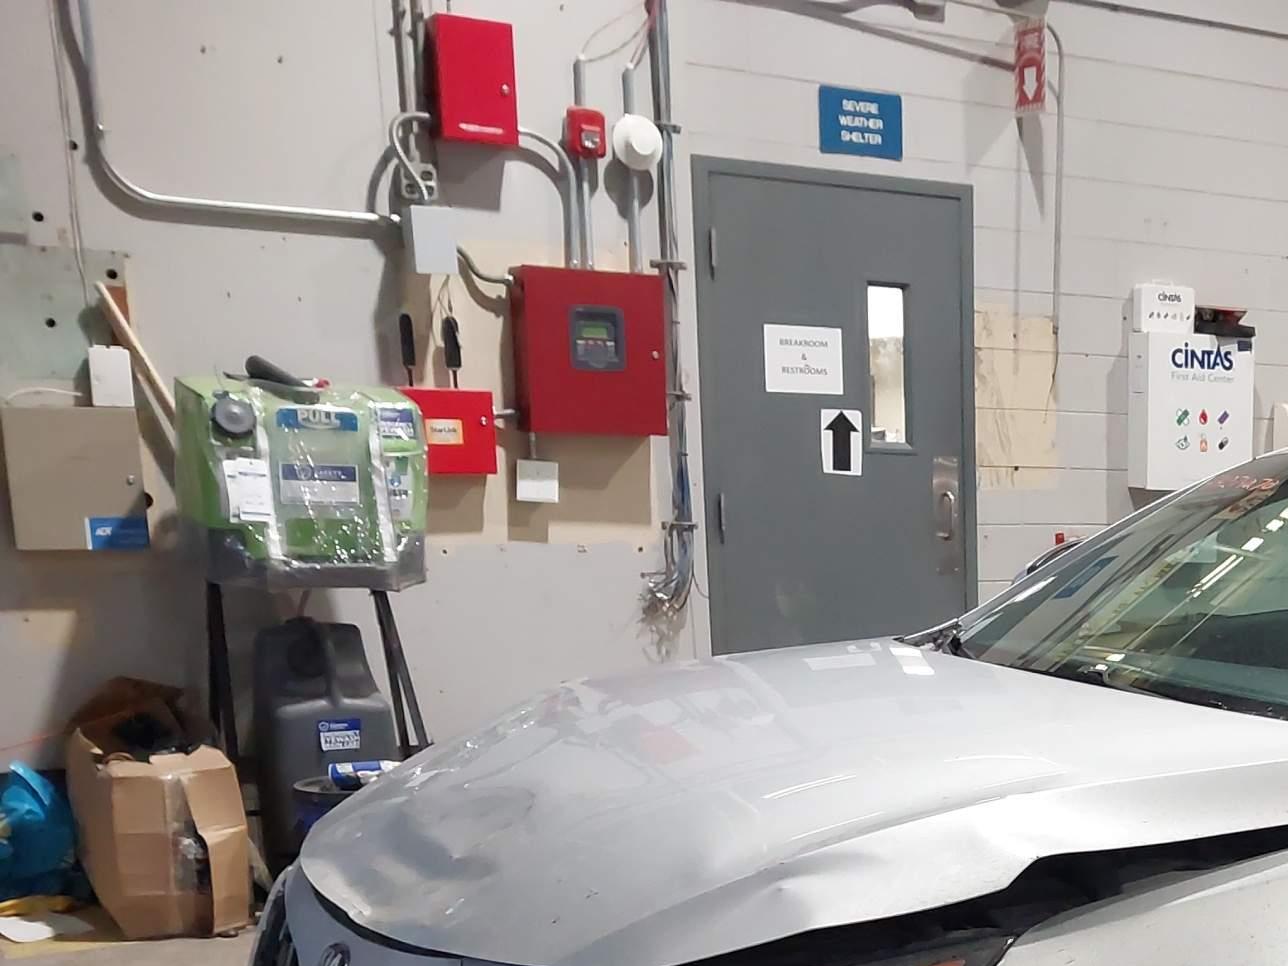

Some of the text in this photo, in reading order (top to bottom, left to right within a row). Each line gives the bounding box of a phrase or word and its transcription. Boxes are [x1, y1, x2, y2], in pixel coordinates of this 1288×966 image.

[842, 99, 879, 114] SEVERE
[838, 114, 883, 129] WEATHER
[840, 130, 882, 144] SHELTER
[779, 338, 828, 347] BREAKROOM
[781, 366, 828, 375] RESTROOMS
[1171, 371, 1234, 383] First Aid Center
